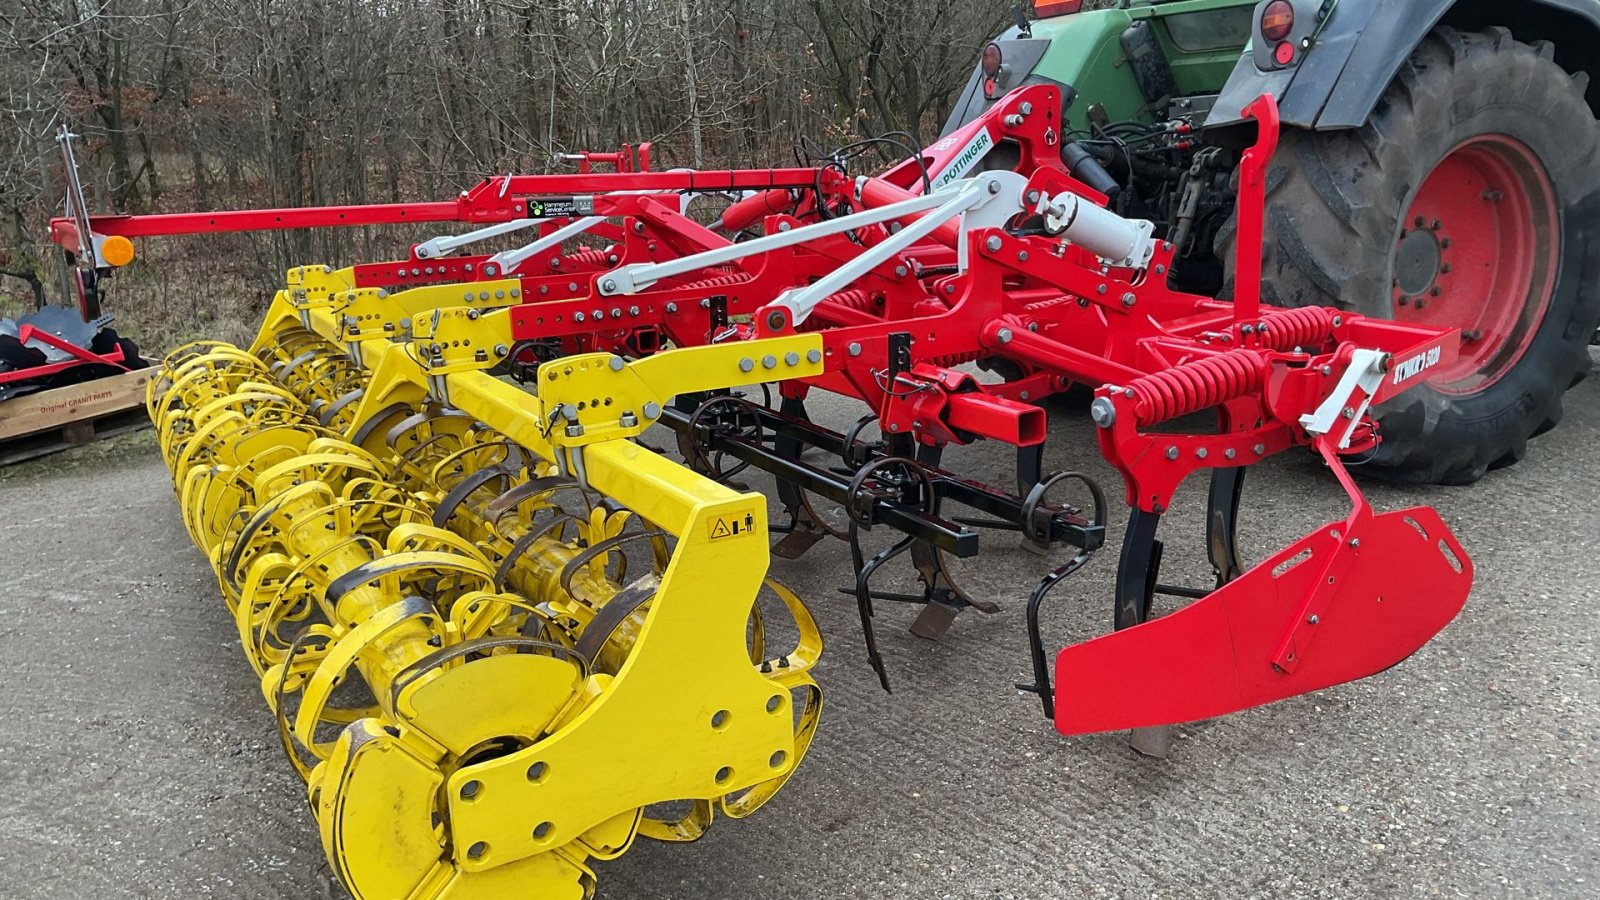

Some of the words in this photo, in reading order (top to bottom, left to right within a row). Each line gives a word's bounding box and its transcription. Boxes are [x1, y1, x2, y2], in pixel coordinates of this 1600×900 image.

[40, 402, 67, 413] Original
[68, 396, 92, 407] GRANIT
[93, 391, 112, 400] PARTS
